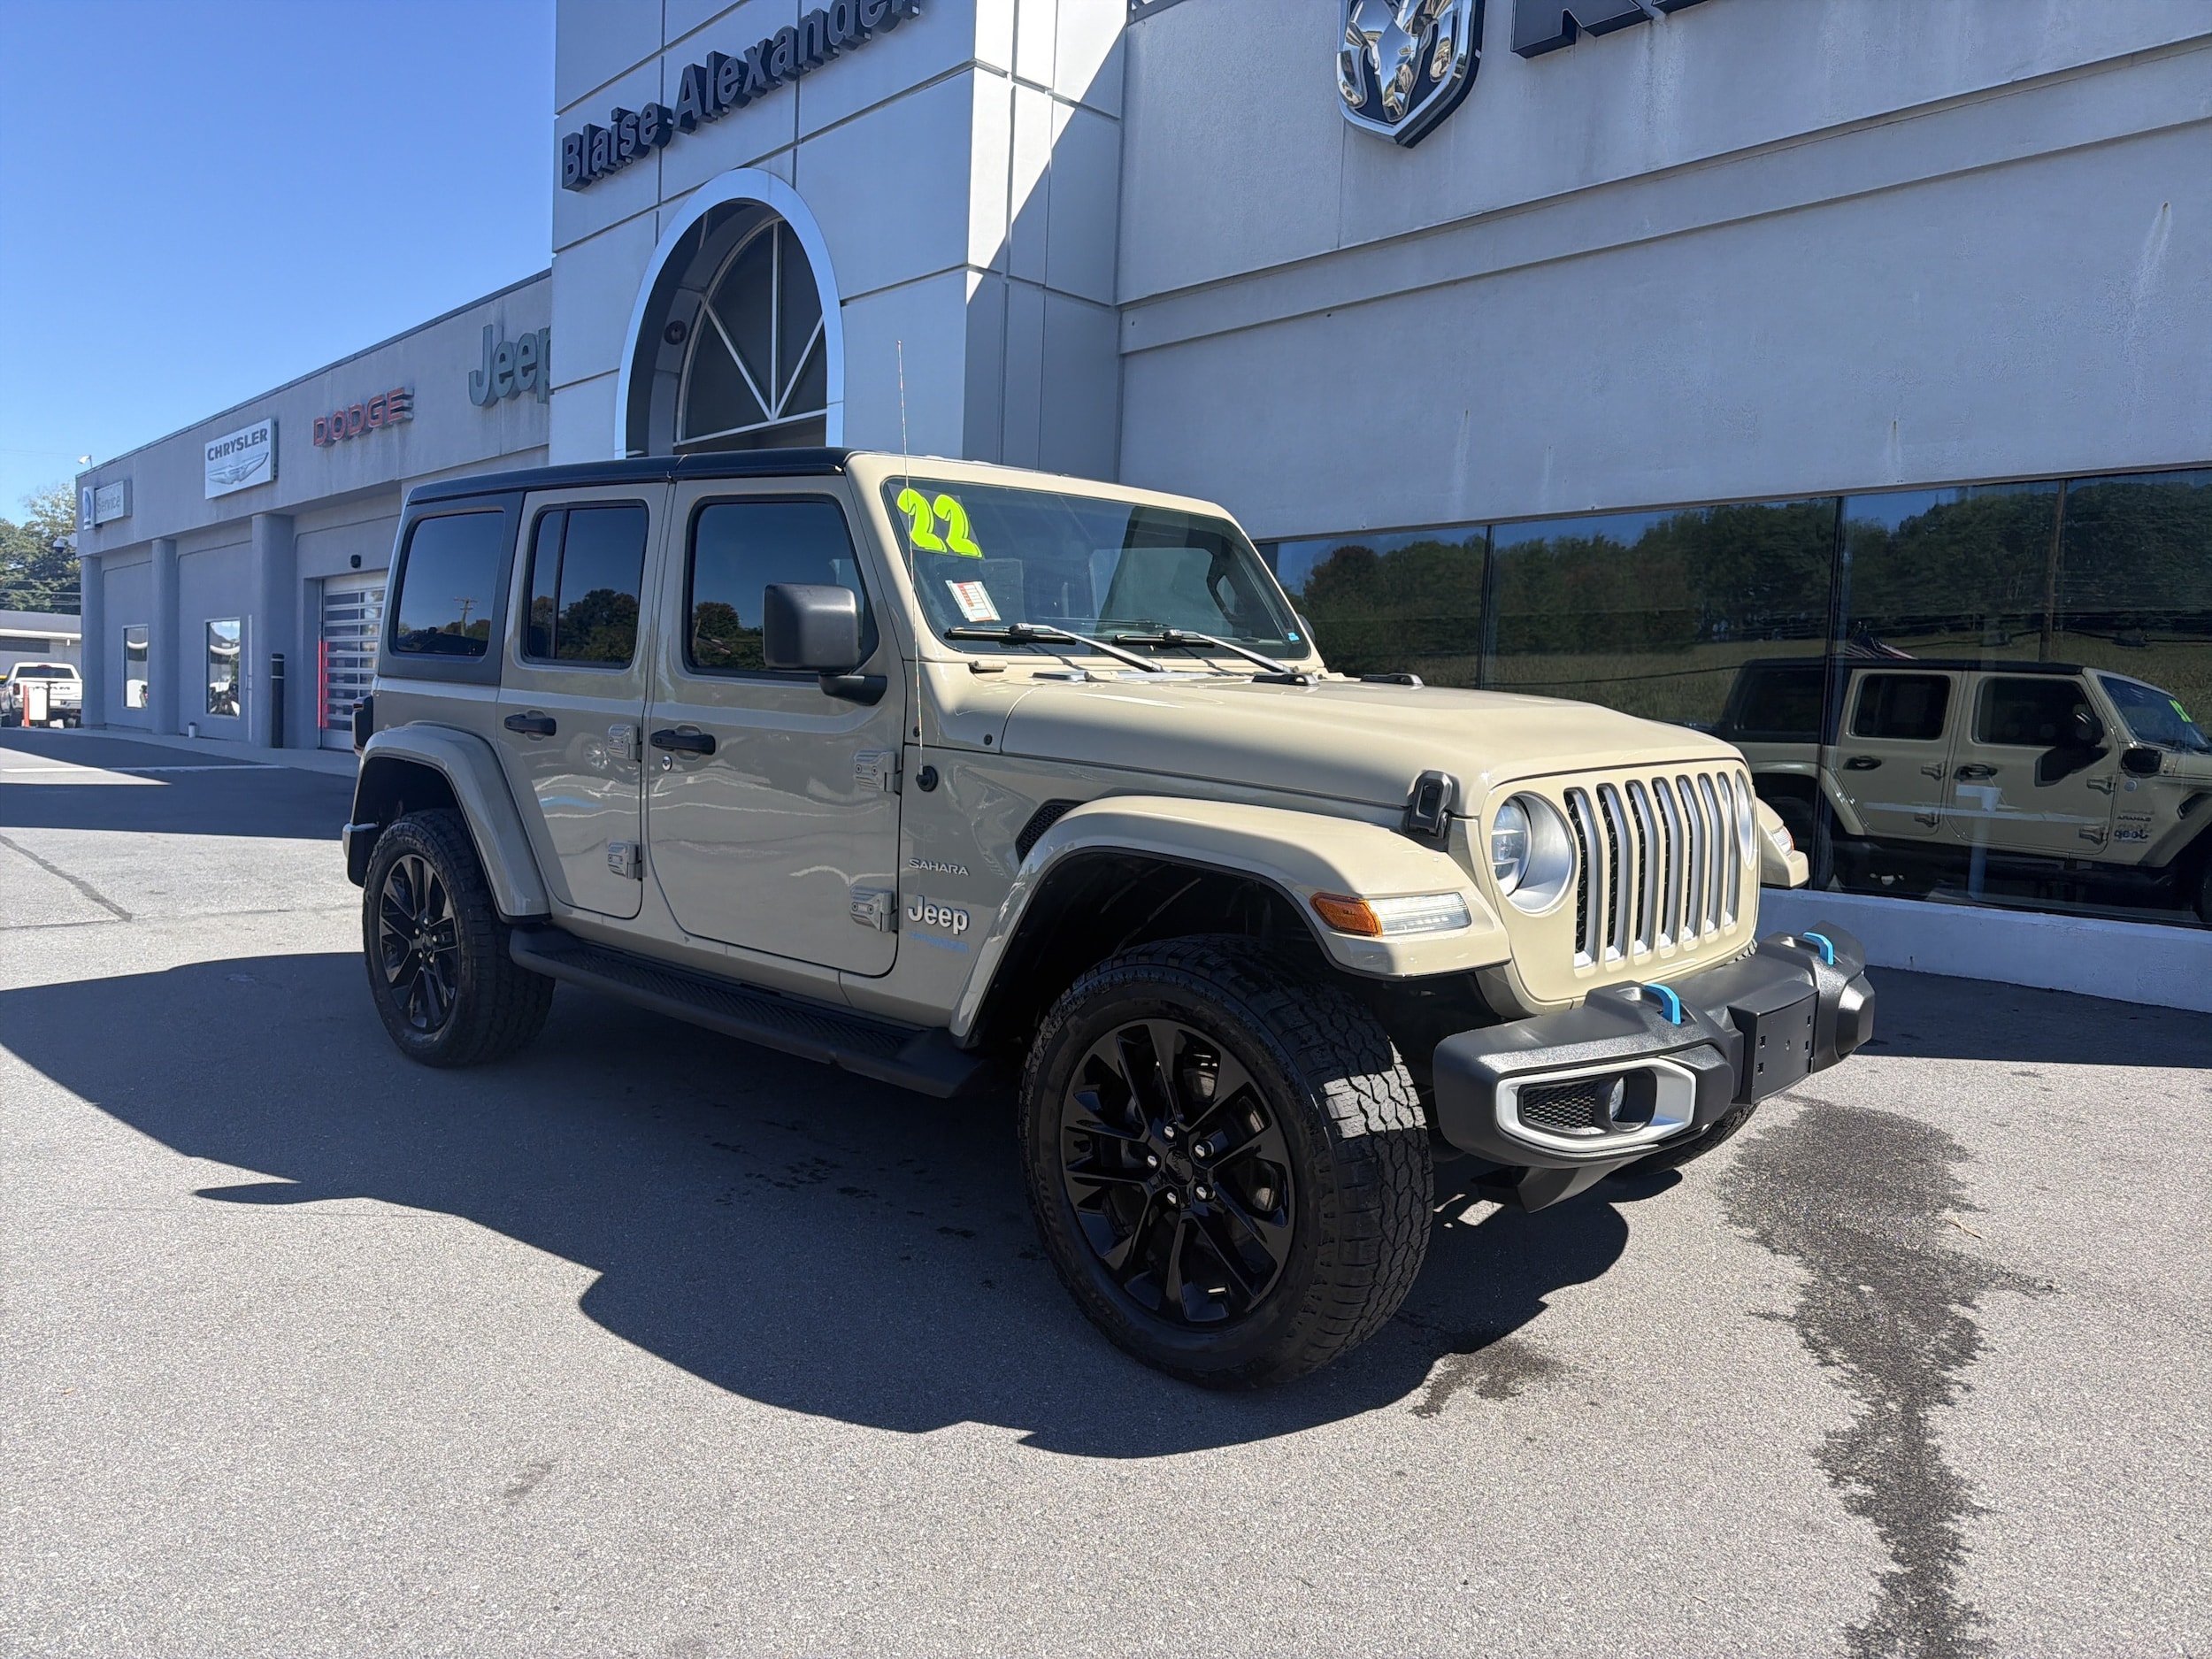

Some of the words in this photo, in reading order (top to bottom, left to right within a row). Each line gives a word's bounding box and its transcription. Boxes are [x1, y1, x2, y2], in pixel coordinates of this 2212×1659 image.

[562, 103, 672, 191] Blaise
[673, 0, 920, 134] Alexande
[314, 387, 412, 447] DODGE
[207, 428, 268, 461] CHRYSLER
[896, 488, 983, 559] 22
[908, 857, 970, 876] SAHARA
[907, 895, 970, 935] Jeep
